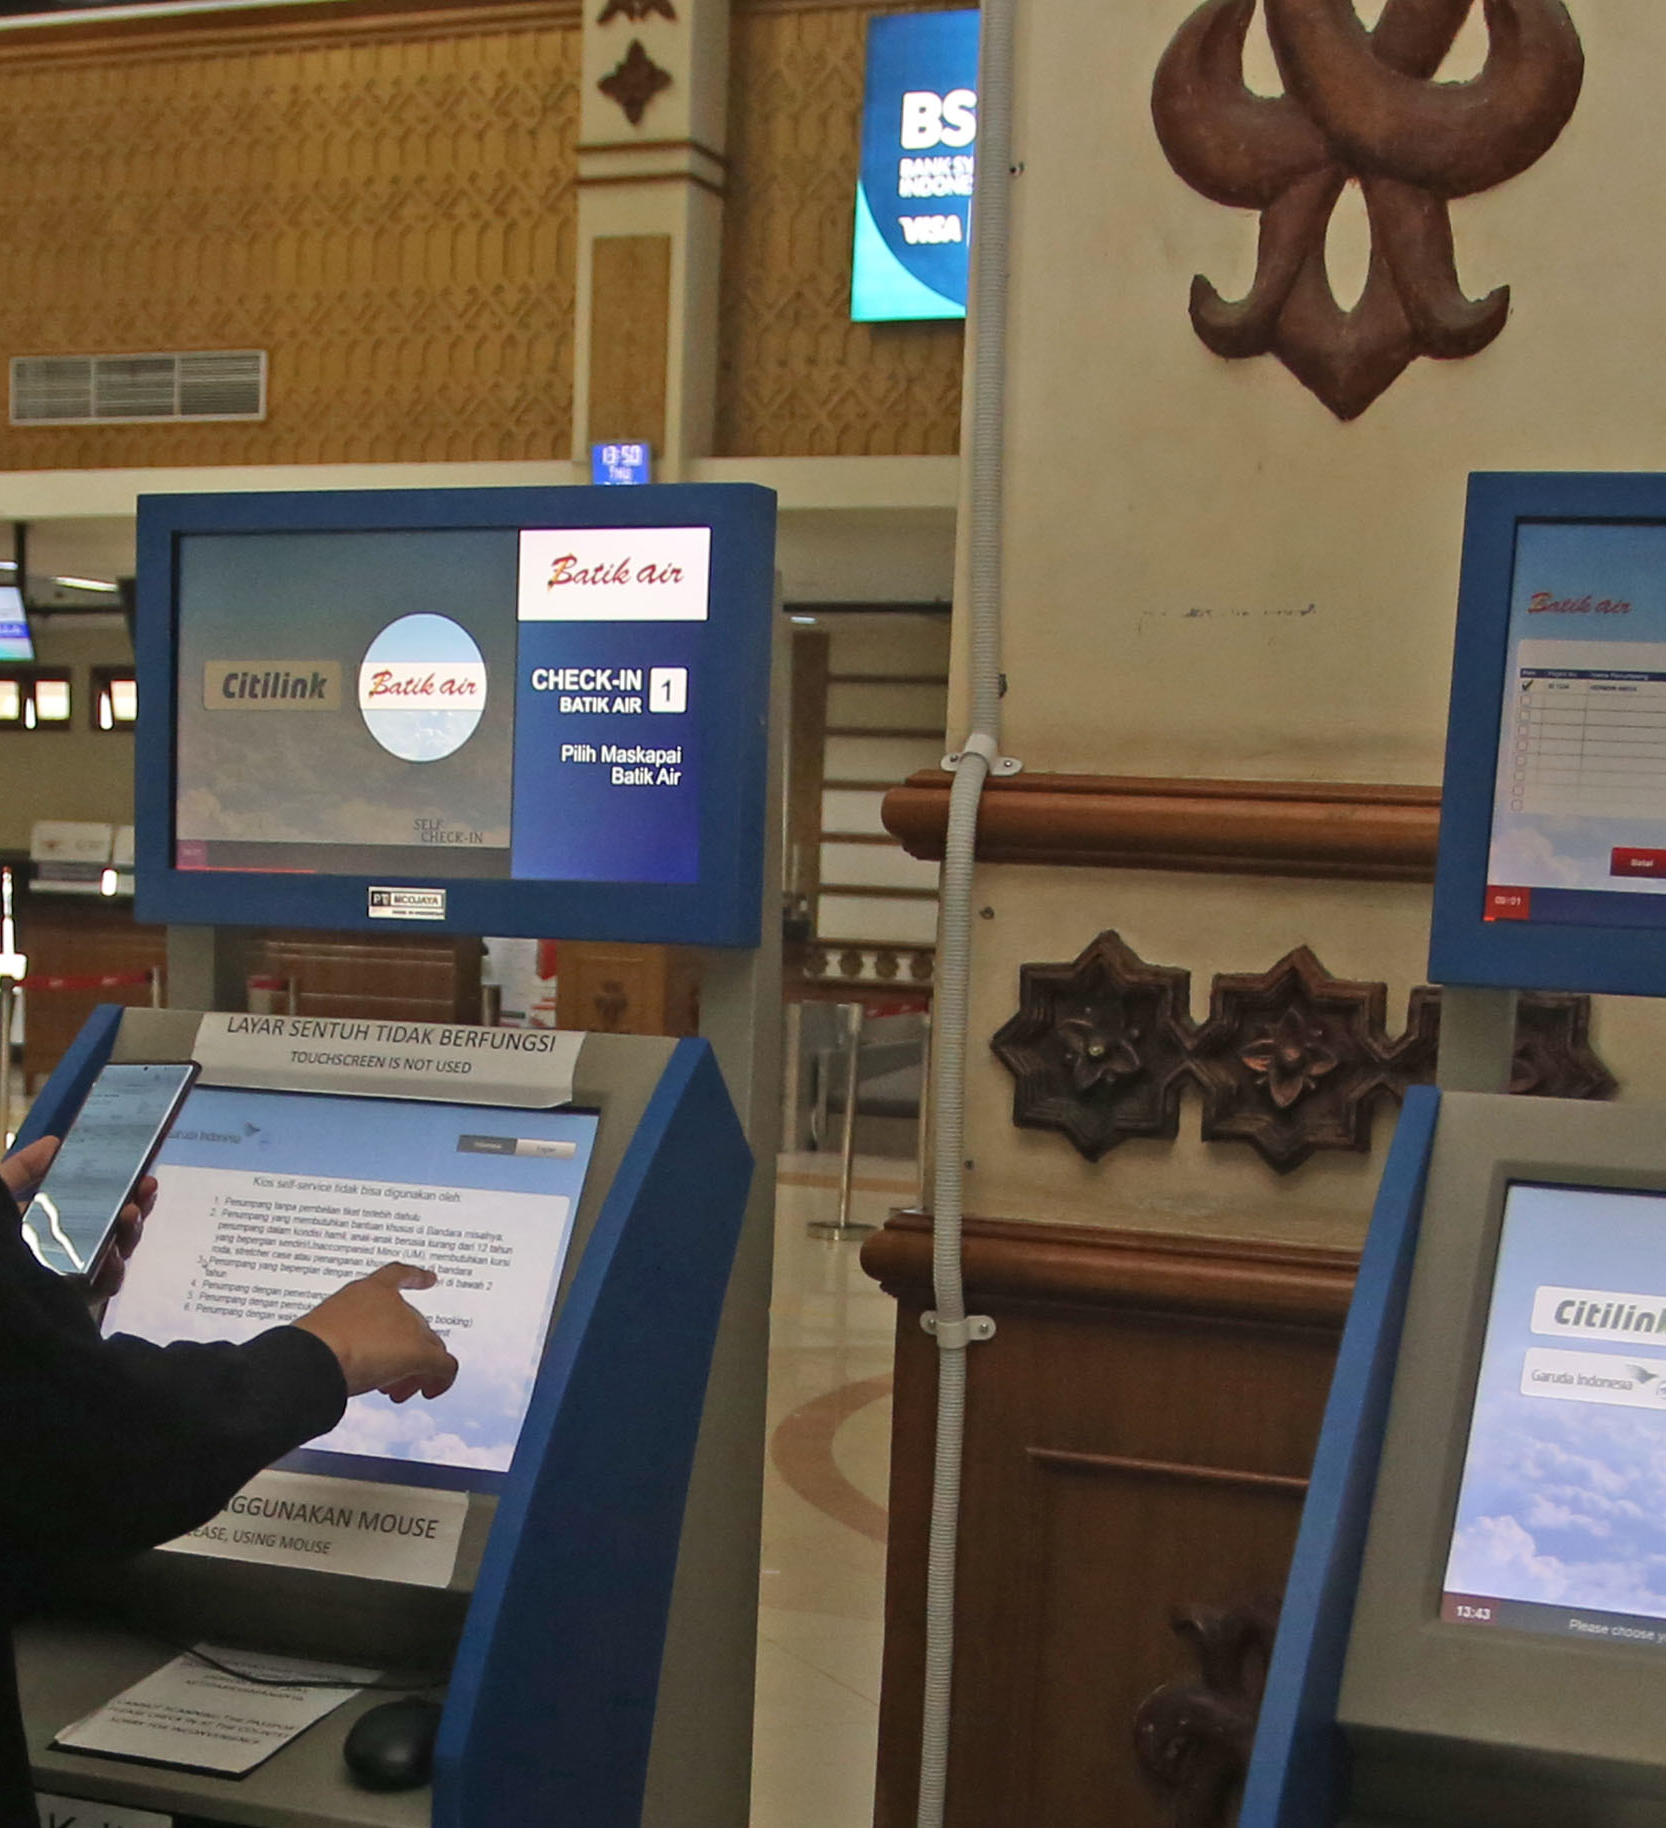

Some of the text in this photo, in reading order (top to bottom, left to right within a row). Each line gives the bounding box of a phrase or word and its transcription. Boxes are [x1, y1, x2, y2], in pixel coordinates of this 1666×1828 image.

[898, 214, 962, 244] VISA
[547, 553, 685, 592] Batik air
[222, 671, 328, 700] Citilink
[368, 668, 478, 702] Batik air
[531, 667, 672, 702] CHECK-IN 1
[559, 696, 643, 714] BATIK AIR
[561, 744, 682, 767] Pilih Maskapai
[611, 766, 682, 786] Batik Air
[421, 831, 484, 845] CHECK-IN
[226, 1016, 556, 1053] LAYAR SENTUH TIDAK BERFUNGSI
[290, 1050, 472, 1074] TOUCHSCREEN IS NOT USED
[1531, 1368, 1633, 1391] Garuda Indonesia
[358, 1511, 439, 1540] MOUSE
[233, 1530, 282, 1548] USING
[279, 1535, 332, 1555] MOUSE
[1457, 1605, 1491, 1621] 13:43
[1569, 1618, 1609, 1635] Please
[1611, 1624, 1655, 1641] choose
